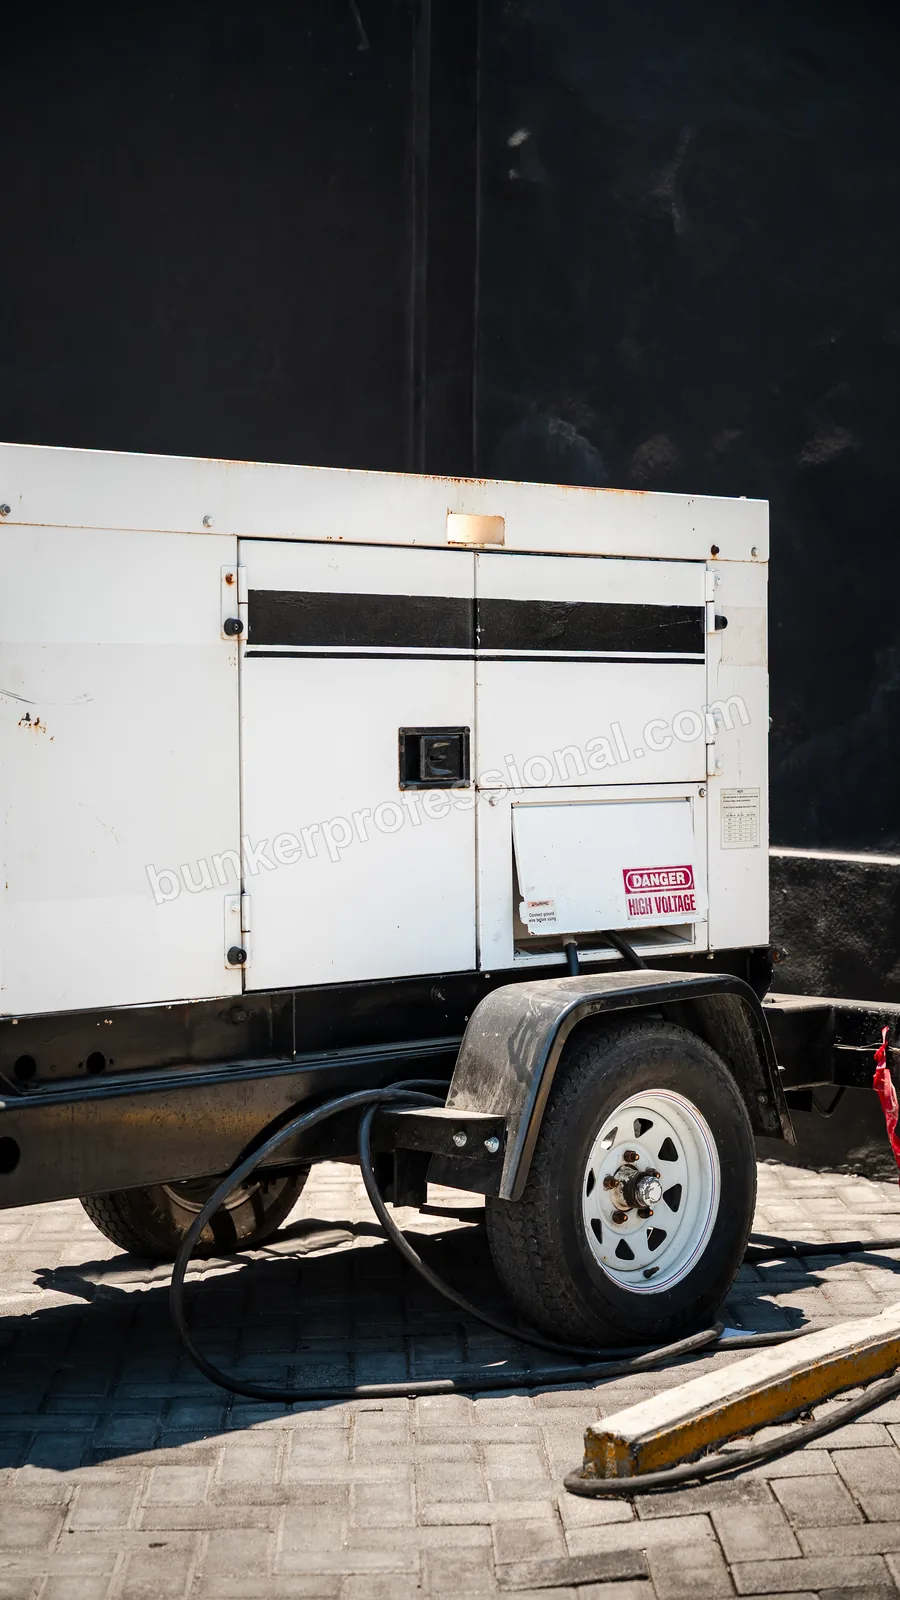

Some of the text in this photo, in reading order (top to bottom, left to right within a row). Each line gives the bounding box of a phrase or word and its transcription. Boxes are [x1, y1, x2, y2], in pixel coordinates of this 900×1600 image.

[632, 872, 686, 887] DANGER
[628, 894, 697, 916] HIGH VOLTAGE
